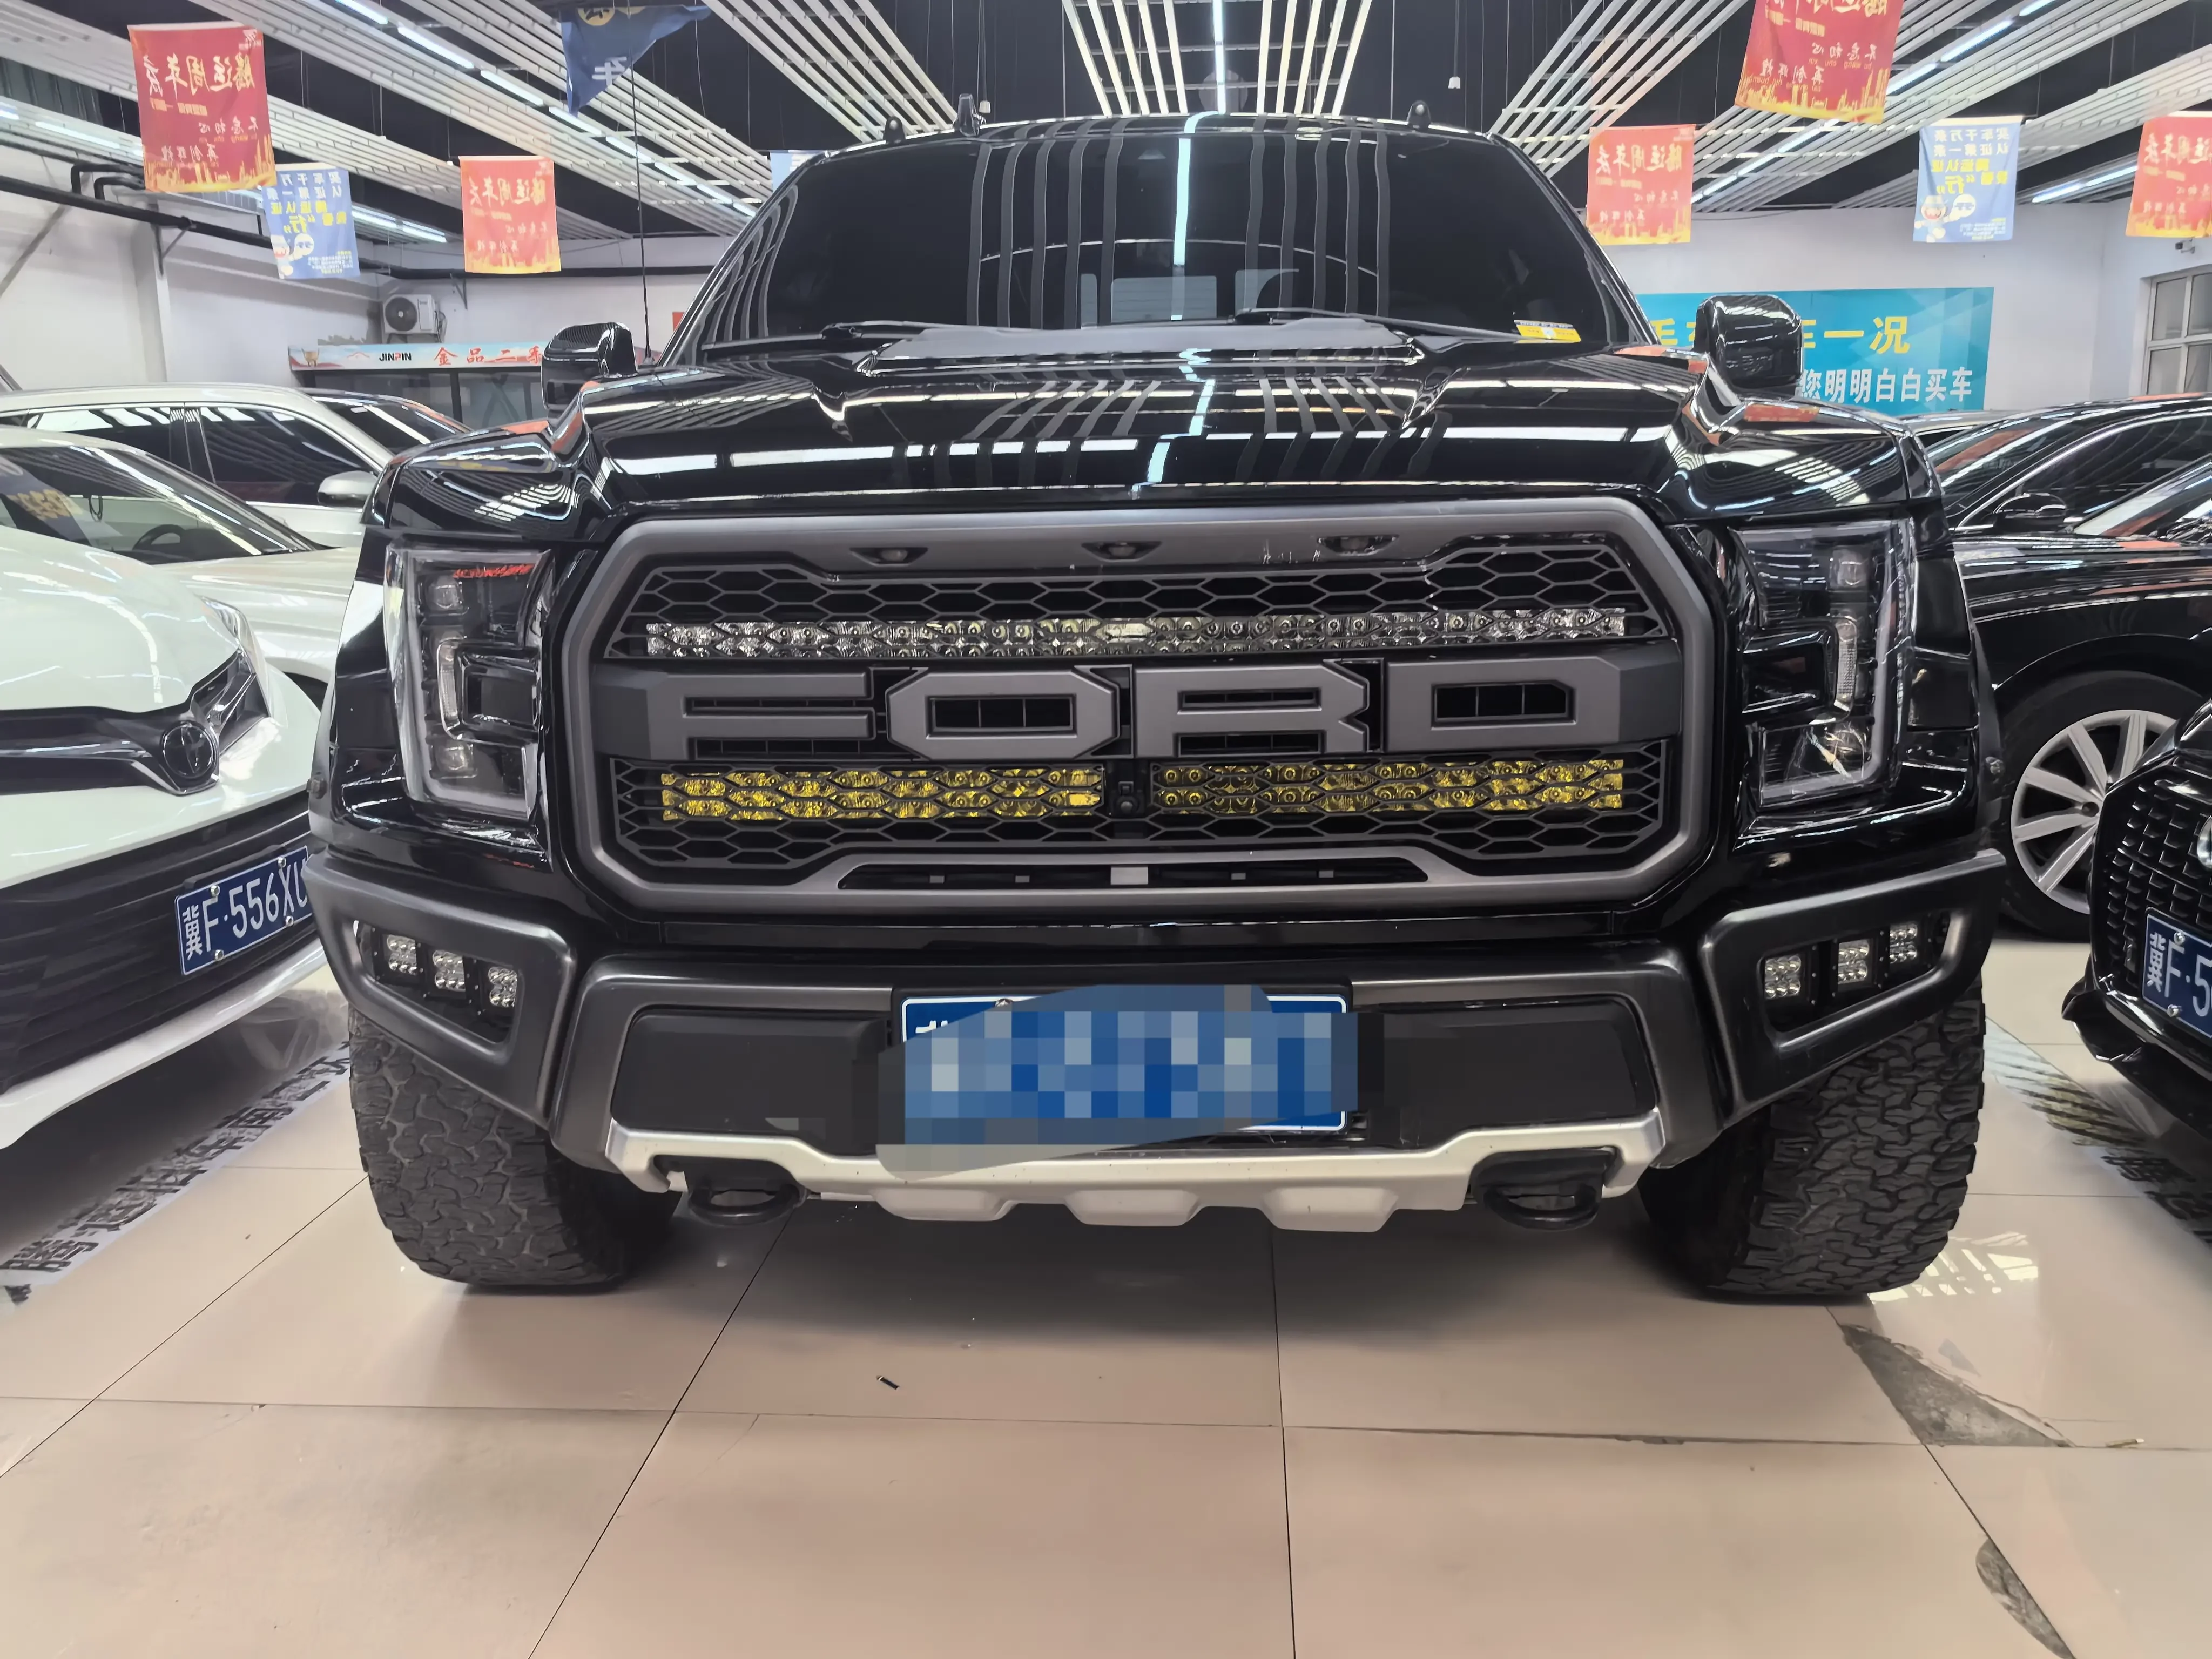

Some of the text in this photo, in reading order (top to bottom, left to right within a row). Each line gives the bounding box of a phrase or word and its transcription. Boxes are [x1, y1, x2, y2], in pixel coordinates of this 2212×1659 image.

[379, 352, 412, 362] JINPIN
[1797, 366, 1973, 403] 您明明白白买车
[646, 655, 1621, 761] FORD
